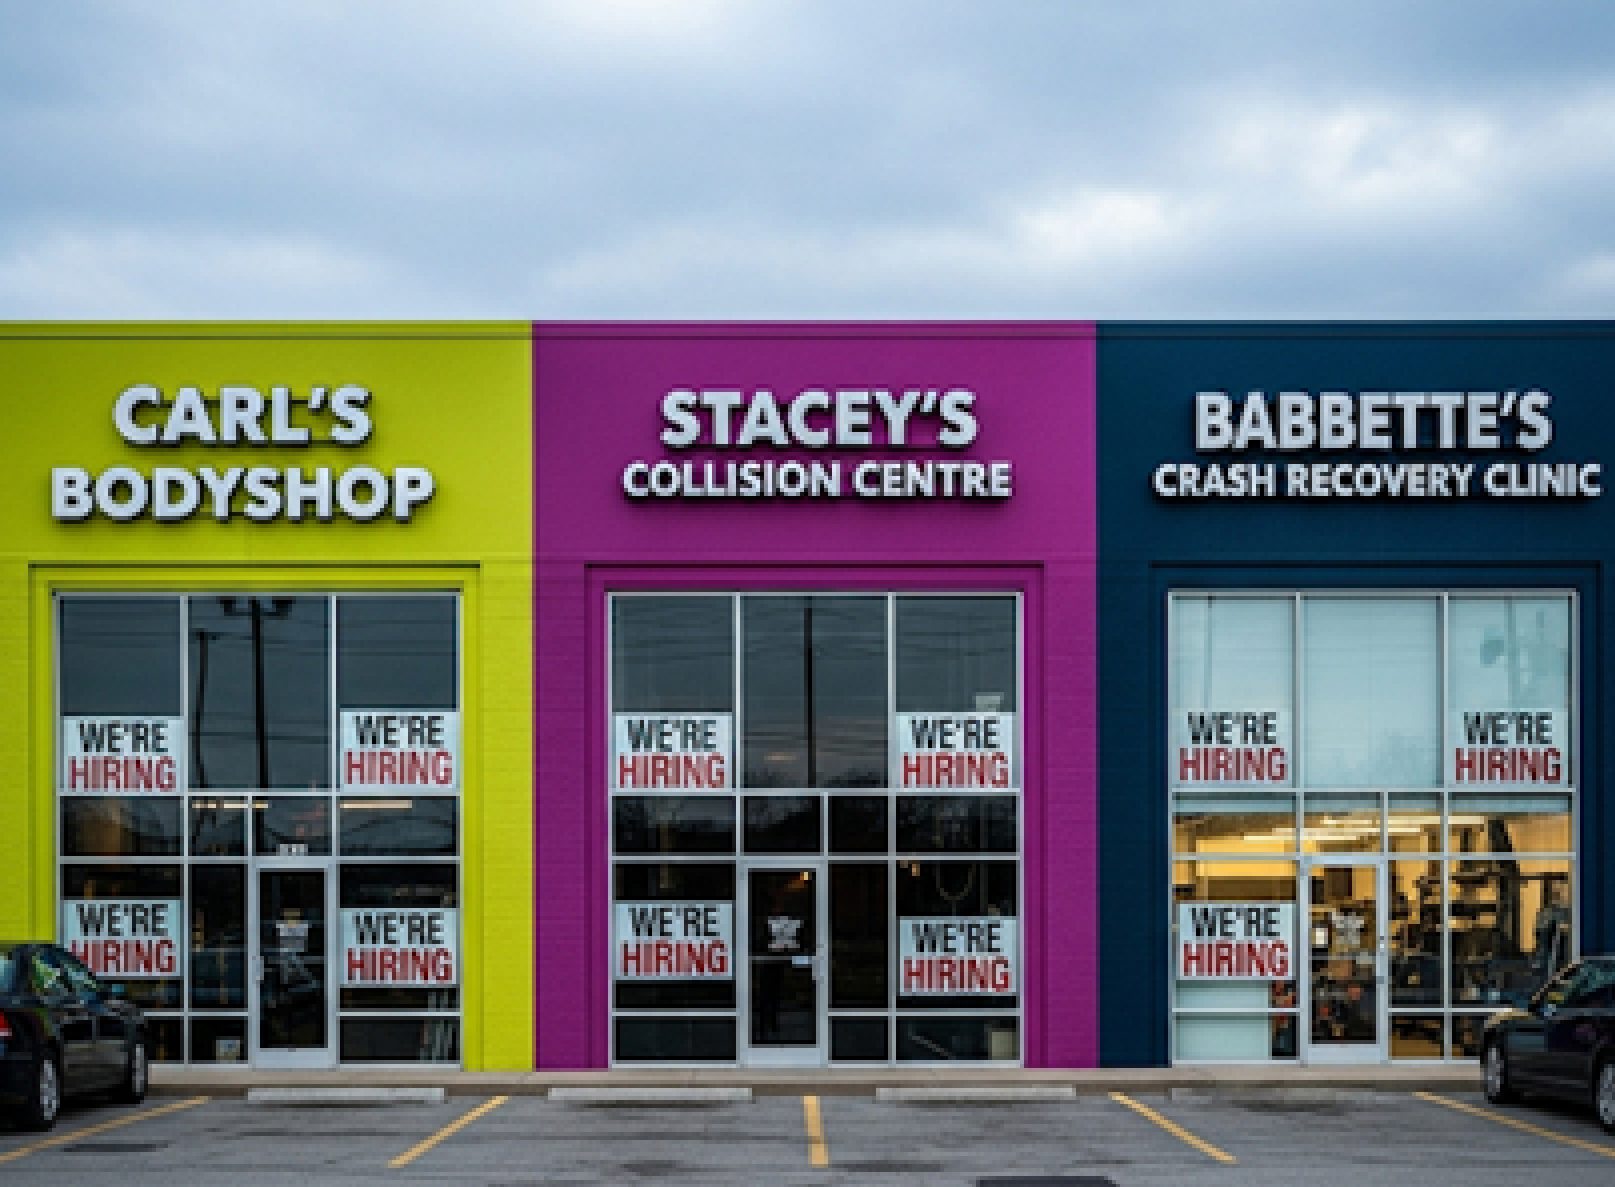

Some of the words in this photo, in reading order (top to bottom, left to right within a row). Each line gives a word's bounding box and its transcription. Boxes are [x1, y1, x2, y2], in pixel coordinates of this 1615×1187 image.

[112, 384, 373, 444] CARL'S
[660, 387, 978, 448] STACEY'S
[1195, 389, 1553, 451] BABBETTE'S
[51, 467, 435, 520] BODYSHOP
[622, 461, 840, 497] COLLISION
[853, 461, 1013, 497] CENTRE
[1153, 463, 1277, 498] CRASH
[1287, 463, 1476, 498] RECOVERY
[1483, 463, 1604, 498] CLINIC
[78, 722, 169, 753] WE'RE
[354, 715, 445, 748] WE'RE
[626, 719, 717, 752] WE'RE
[910, 719, 1001, 749] WE'RE
[1187, 712, 1278, 745] WE'RE
[1463, 712, 1553, 745] WE'RE
[67, 756, 177, 791] HIRING
[344, 751, 453, 785] HIRING
[618, 755, 725, 788] HIRING
[902, 752, 1009, 787] HIRING
[1178, 747, 1289, 782] HIRING
[1454, 747, 1562, 784] HIRING
[76, 904, 169, 936] WE'RE
[354, 911, 442, 945] WE'RE
[628, 907, 721, 937] WE'RE
[1190, 907, 1281, 937] WE'RE
[910, 923, 1002, 952] WE'RE
[346, 948, 451, 982] HIRING
[619, 940, 729, 976] HIRING
[902, 956, 1012, 992] HIRING
[1182, 940, 1290, 976] HIRING
